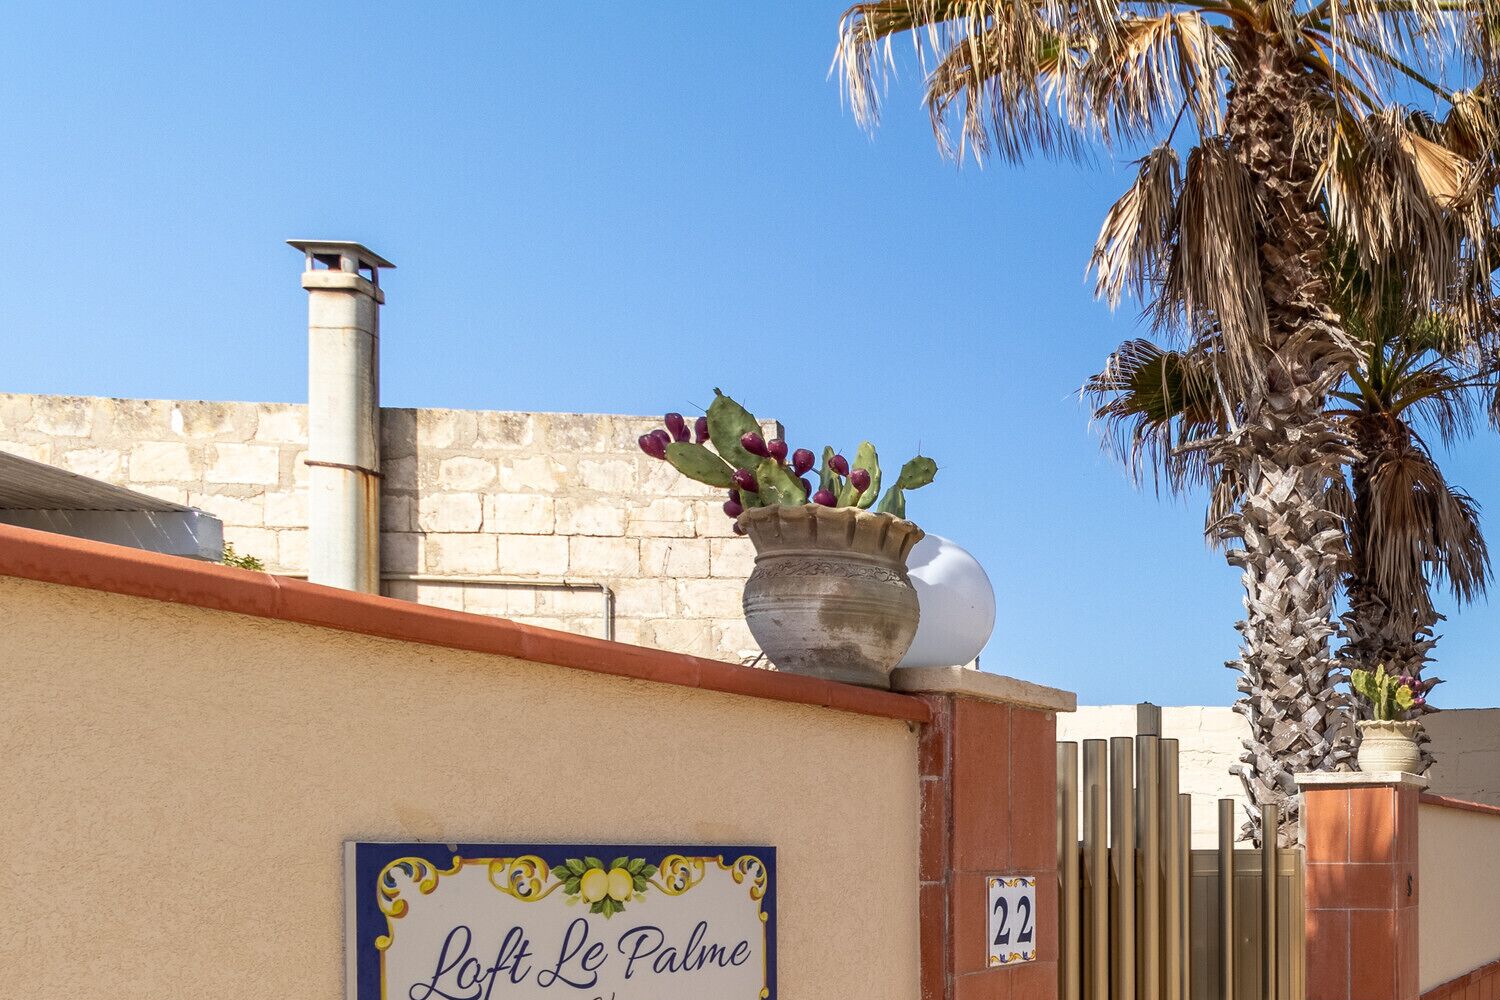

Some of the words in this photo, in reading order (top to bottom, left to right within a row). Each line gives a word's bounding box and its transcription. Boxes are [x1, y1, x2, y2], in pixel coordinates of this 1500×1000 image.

[993, 895, 1033, 946] 22
[537, 918, 607, 989] Le
[617, 920, 751, 979] Palme
